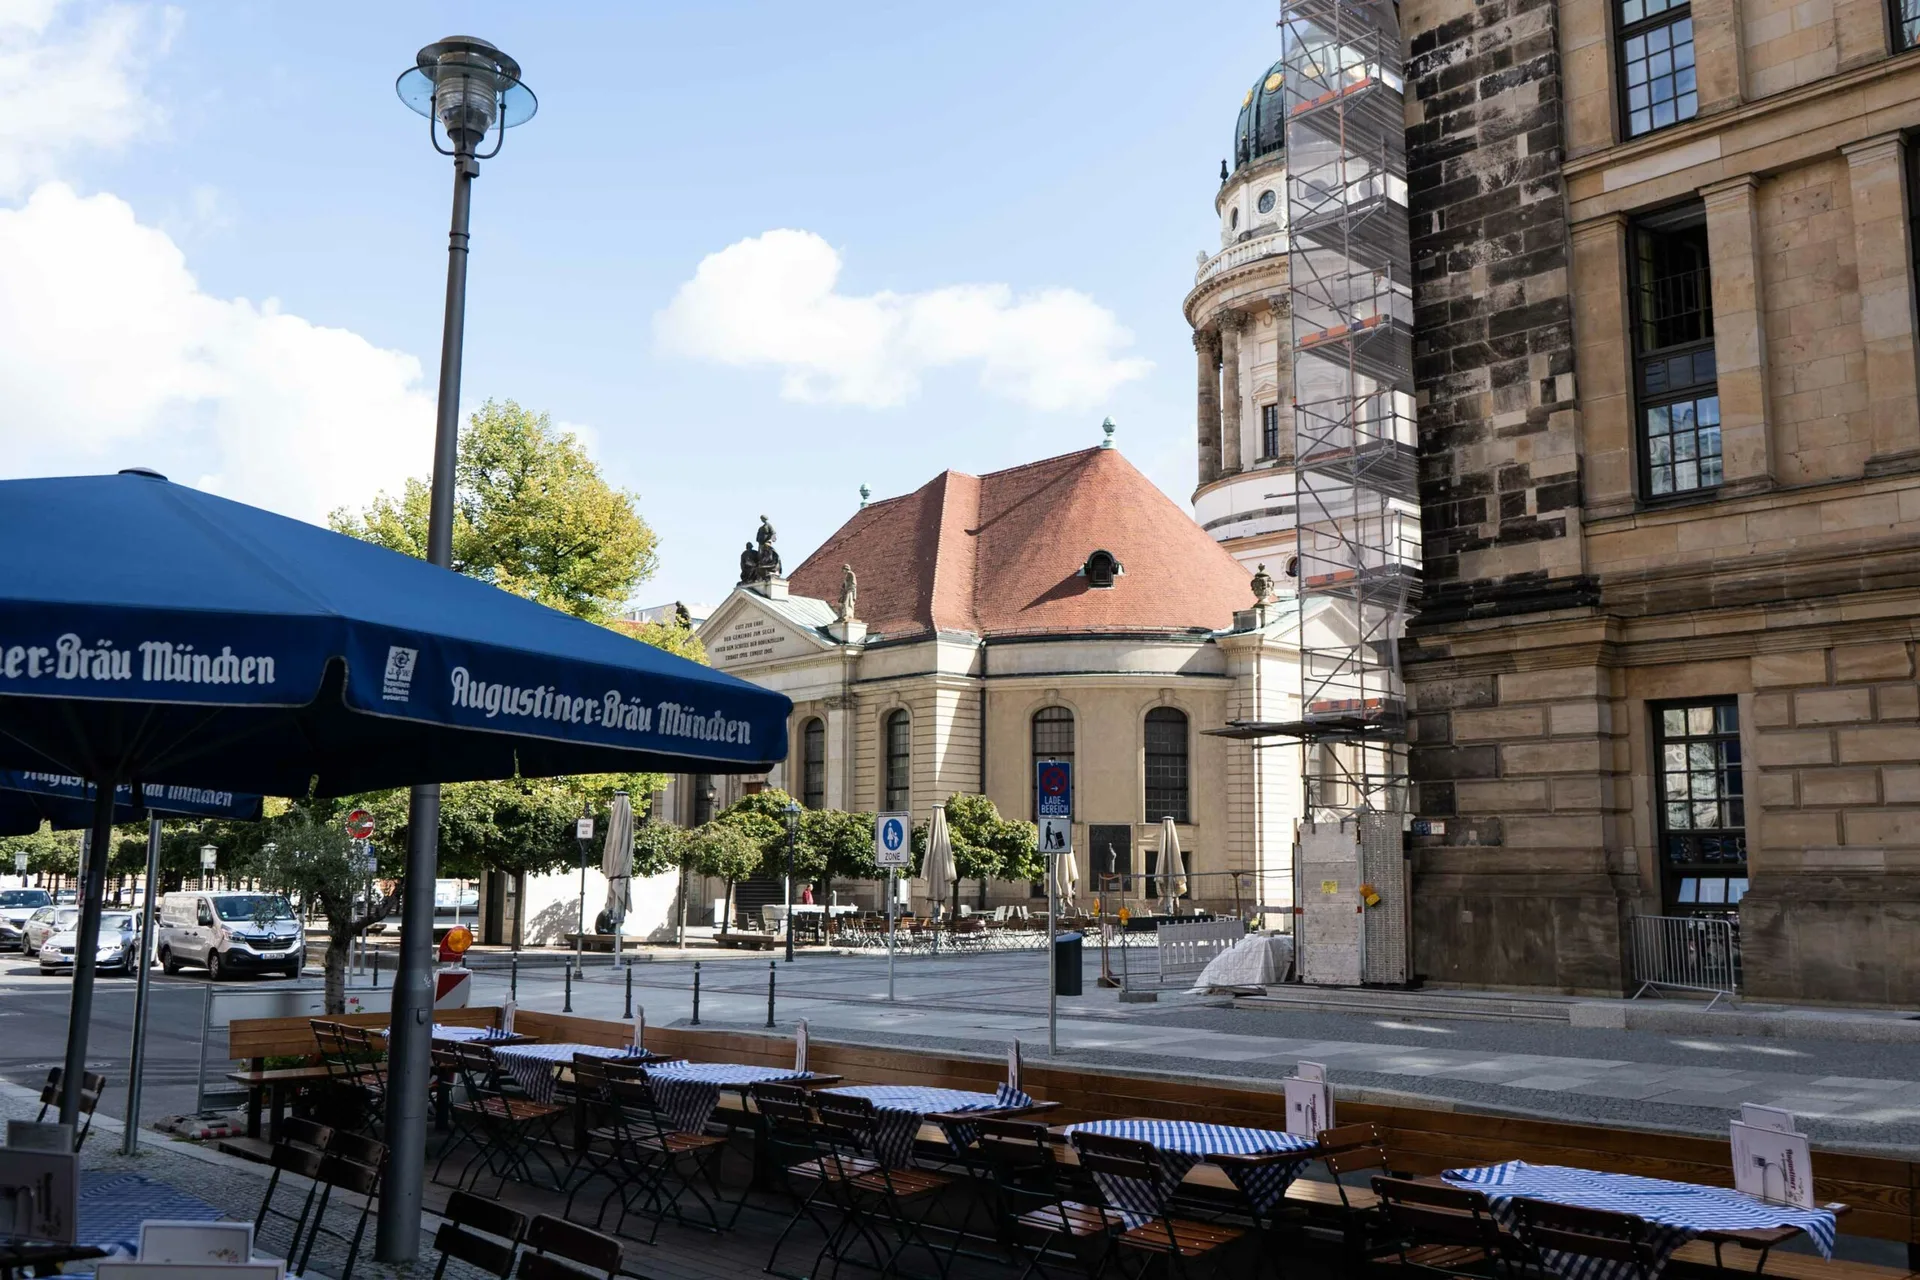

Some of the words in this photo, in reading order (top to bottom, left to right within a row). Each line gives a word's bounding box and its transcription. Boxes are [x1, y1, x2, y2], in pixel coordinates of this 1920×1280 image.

[138, 640, 276, 685] München
[657, 701, 751, 745] München
[1044, 795, 1065, 805] LADE-
[1041, 804, 1069, 814] BEREICH
[884, 852, 901, 861] ZONE
